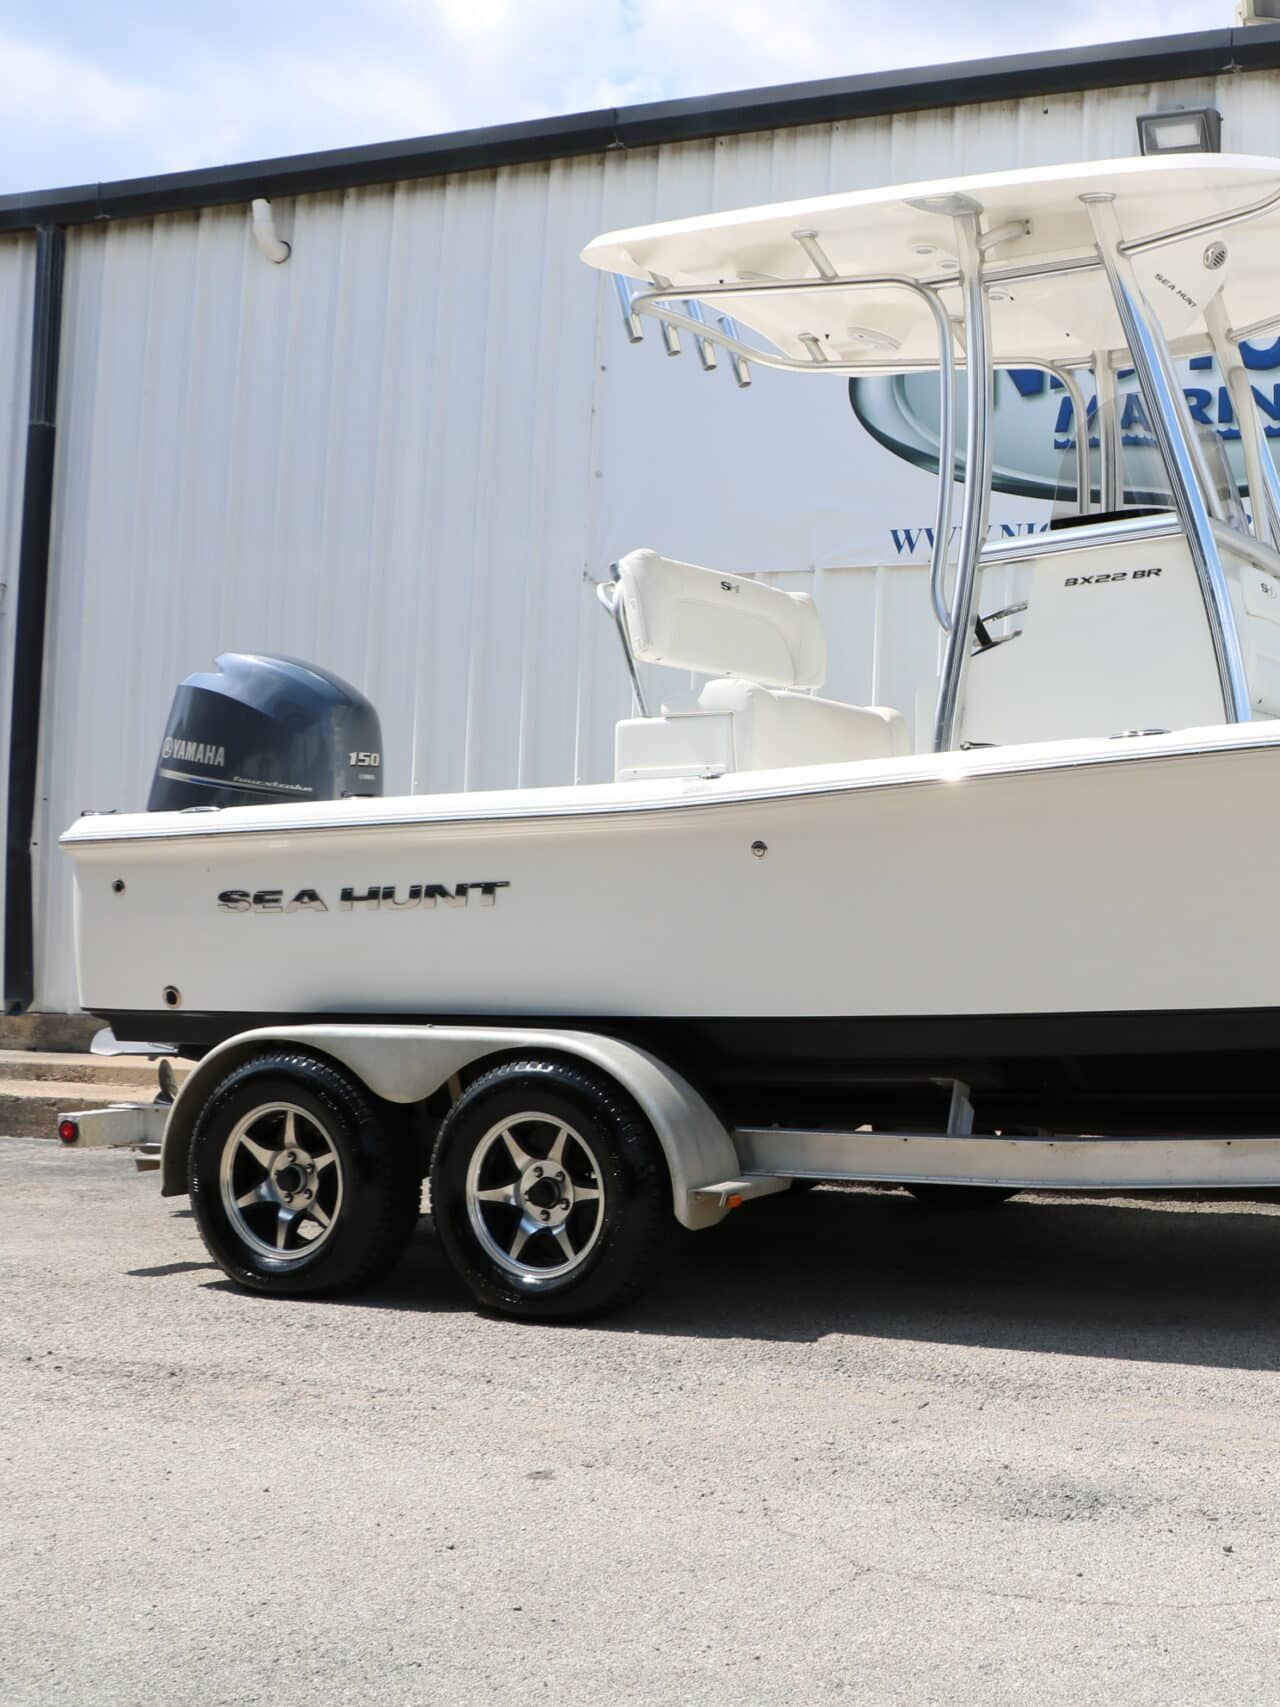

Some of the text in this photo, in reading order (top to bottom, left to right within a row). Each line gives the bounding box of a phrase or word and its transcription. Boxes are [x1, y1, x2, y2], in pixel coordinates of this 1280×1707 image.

[1132, 567, 1163, 580] BR
[173, 738, 225, 768] YAMAHA
[349, 751, 380, 767] 150
[216, 880, 510, 914] SEA HUNT
